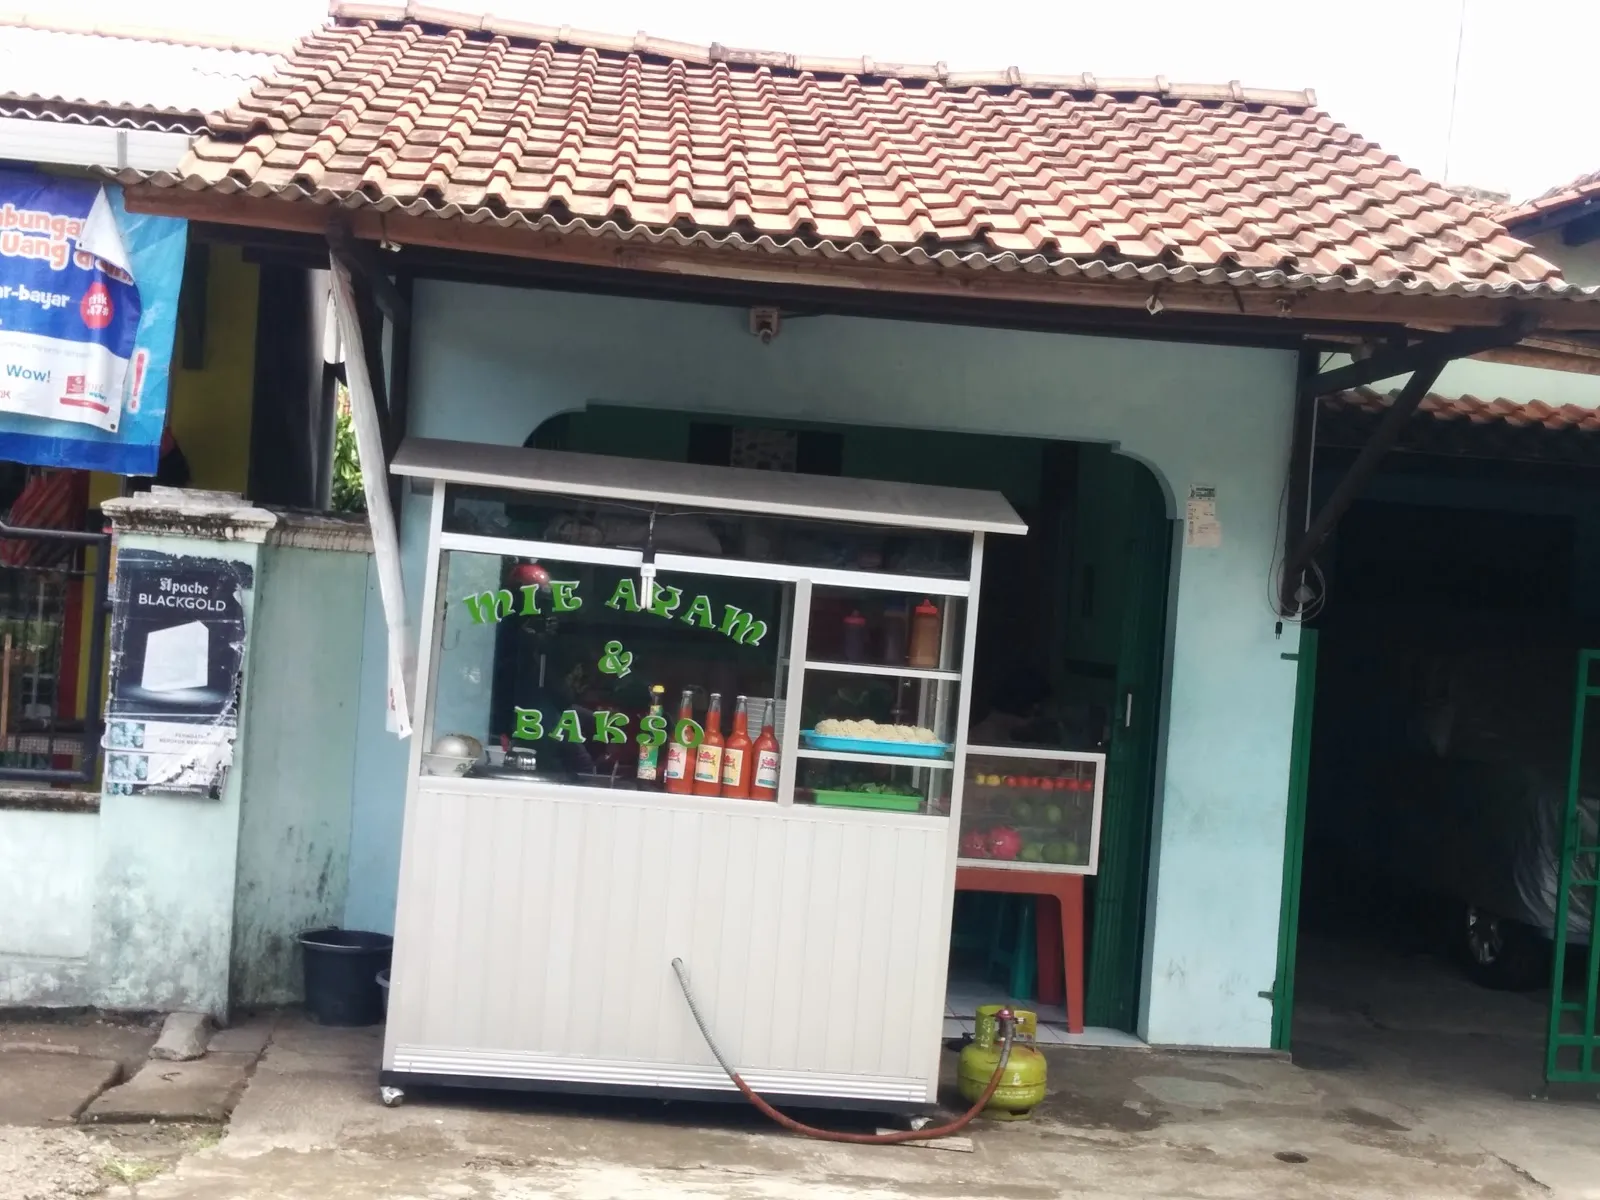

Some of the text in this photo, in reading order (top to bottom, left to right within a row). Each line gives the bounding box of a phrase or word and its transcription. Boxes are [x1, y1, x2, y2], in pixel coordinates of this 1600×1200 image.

[0, 204, 87, 240] bunga
[1, 232, 68, 269] Uang
[7, 364, 51, 383] Wow!
[138, 593, 226, 611] BLACKGOLD
[160, 577, 209, 595] Apache
[463, 578, 768, 646] MIE AYAM
[597, 640, 634, 678] &
[512, 706, 705, 748] BAKSO
